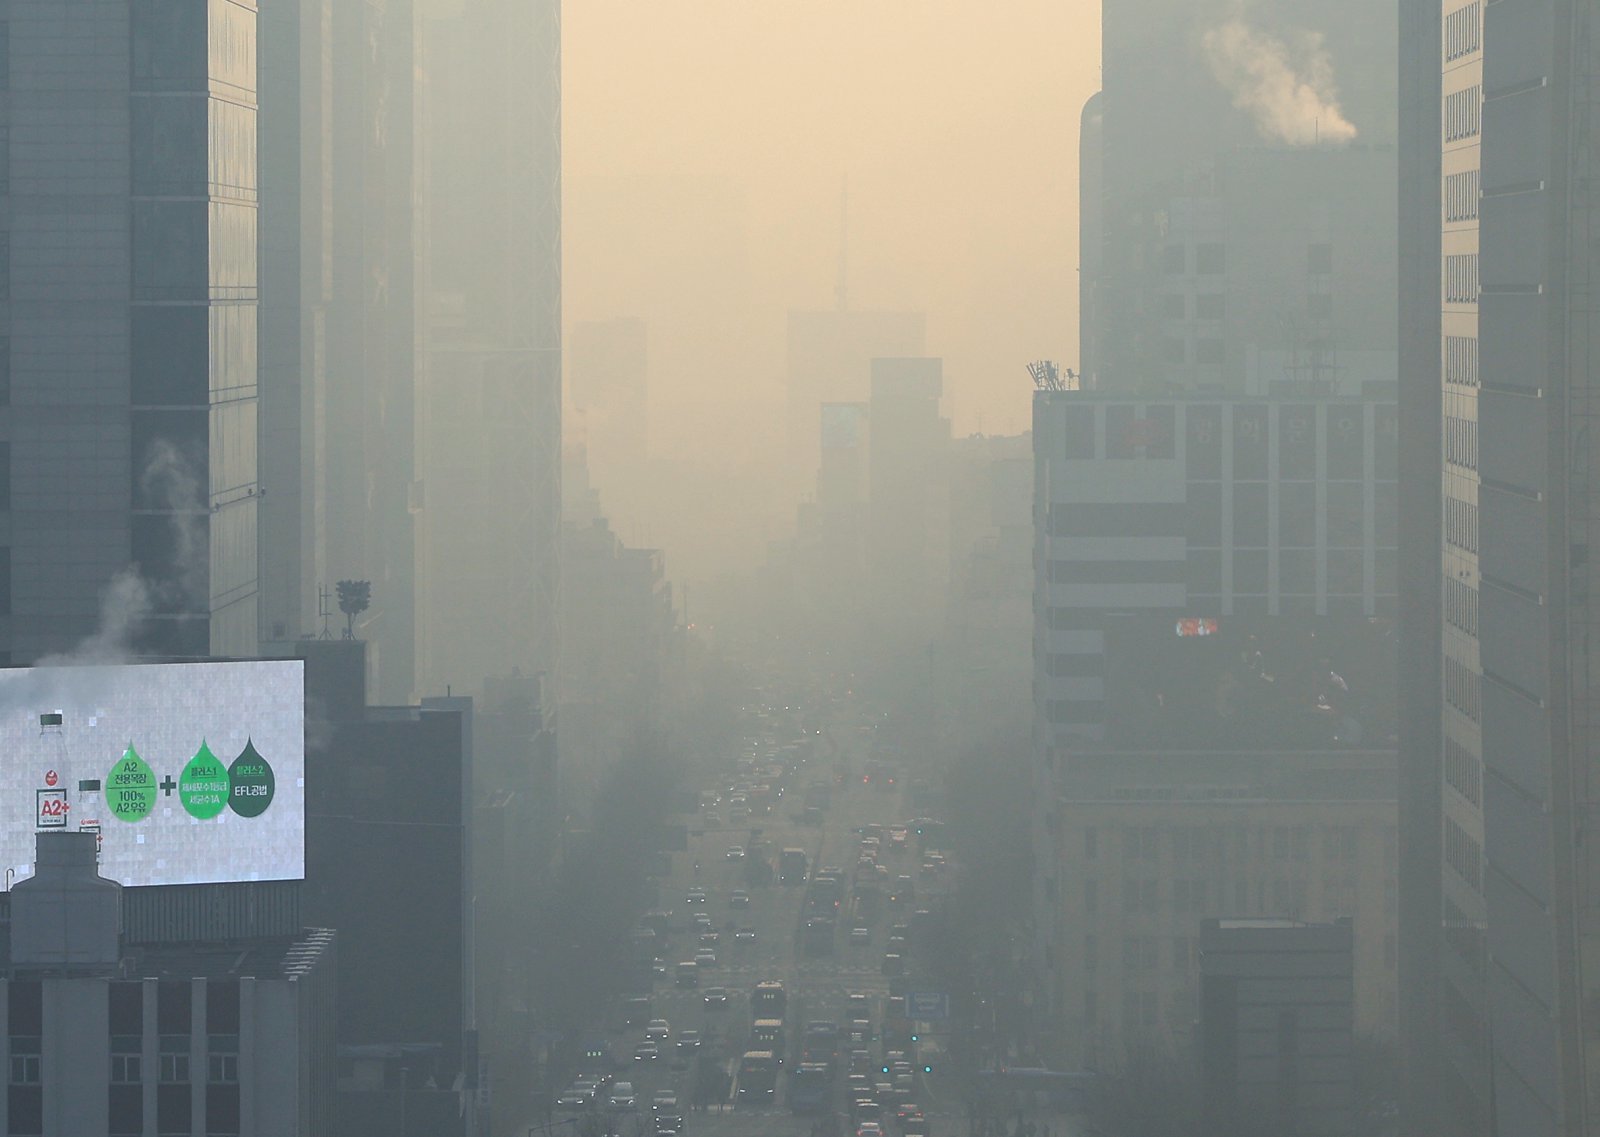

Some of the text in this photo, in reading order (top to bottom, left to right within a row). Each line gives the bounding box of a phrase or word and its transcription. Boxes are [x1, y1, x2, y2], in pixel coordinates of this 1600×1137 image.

[123, 761, 138, 773] A2
[114, 773, 147, 785] 전용목장
[120, 790, 146, 802] 100%
[234, 784, 268, 797] EFL공법
[41, 799, 70, 816] A2+
